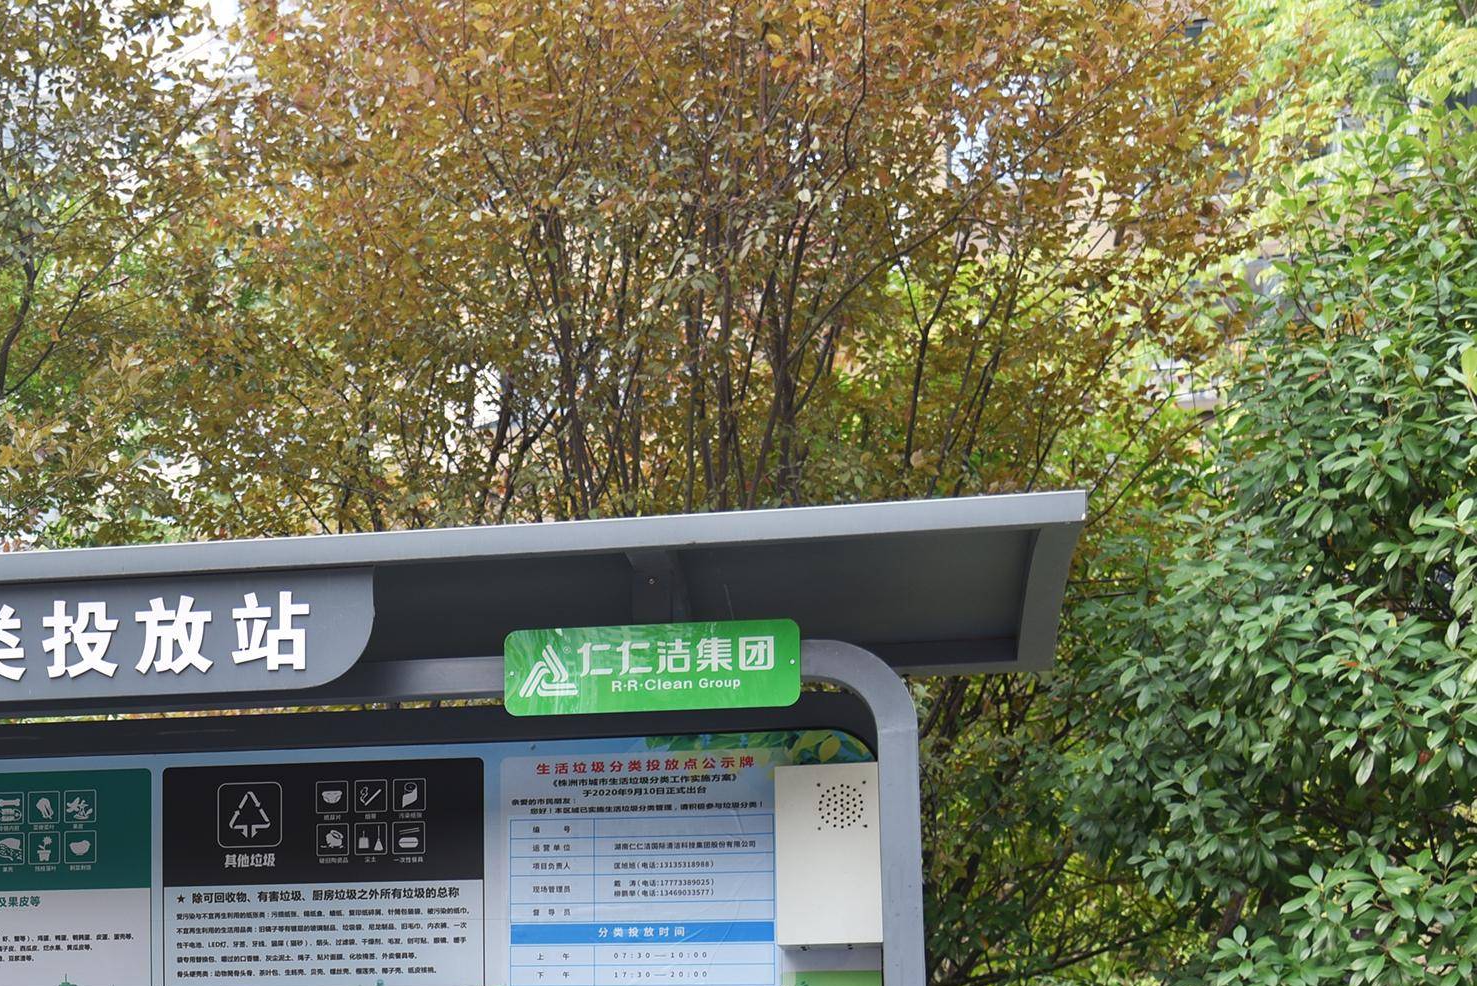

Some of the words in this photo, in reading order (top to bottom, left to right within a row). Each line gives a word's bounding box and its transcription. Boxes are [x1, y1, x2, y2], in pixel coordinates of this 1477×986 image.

[577, 636, 774, 677] 仁仁洁集团
[698, 677, 741, 690] Group
[536, 756, 755, 775] 生活垃圾分类投放点公示牌
[582, 785, 707, 798] 于2020年9月10日正式出台
[532, 825, 571, 834] 编号
[532, 843, 571, 852] 运营单位
[224, 853, 276, 869] 其他垃圾
[532, 862, 571, 871] 项目负责人
[532, 884, 571, 894] 现场管理员
[597, 926, 686, 939] 分类投放时间
[536, 952, 570, 961] 上午
[536, 970, 570, 979] 下午
